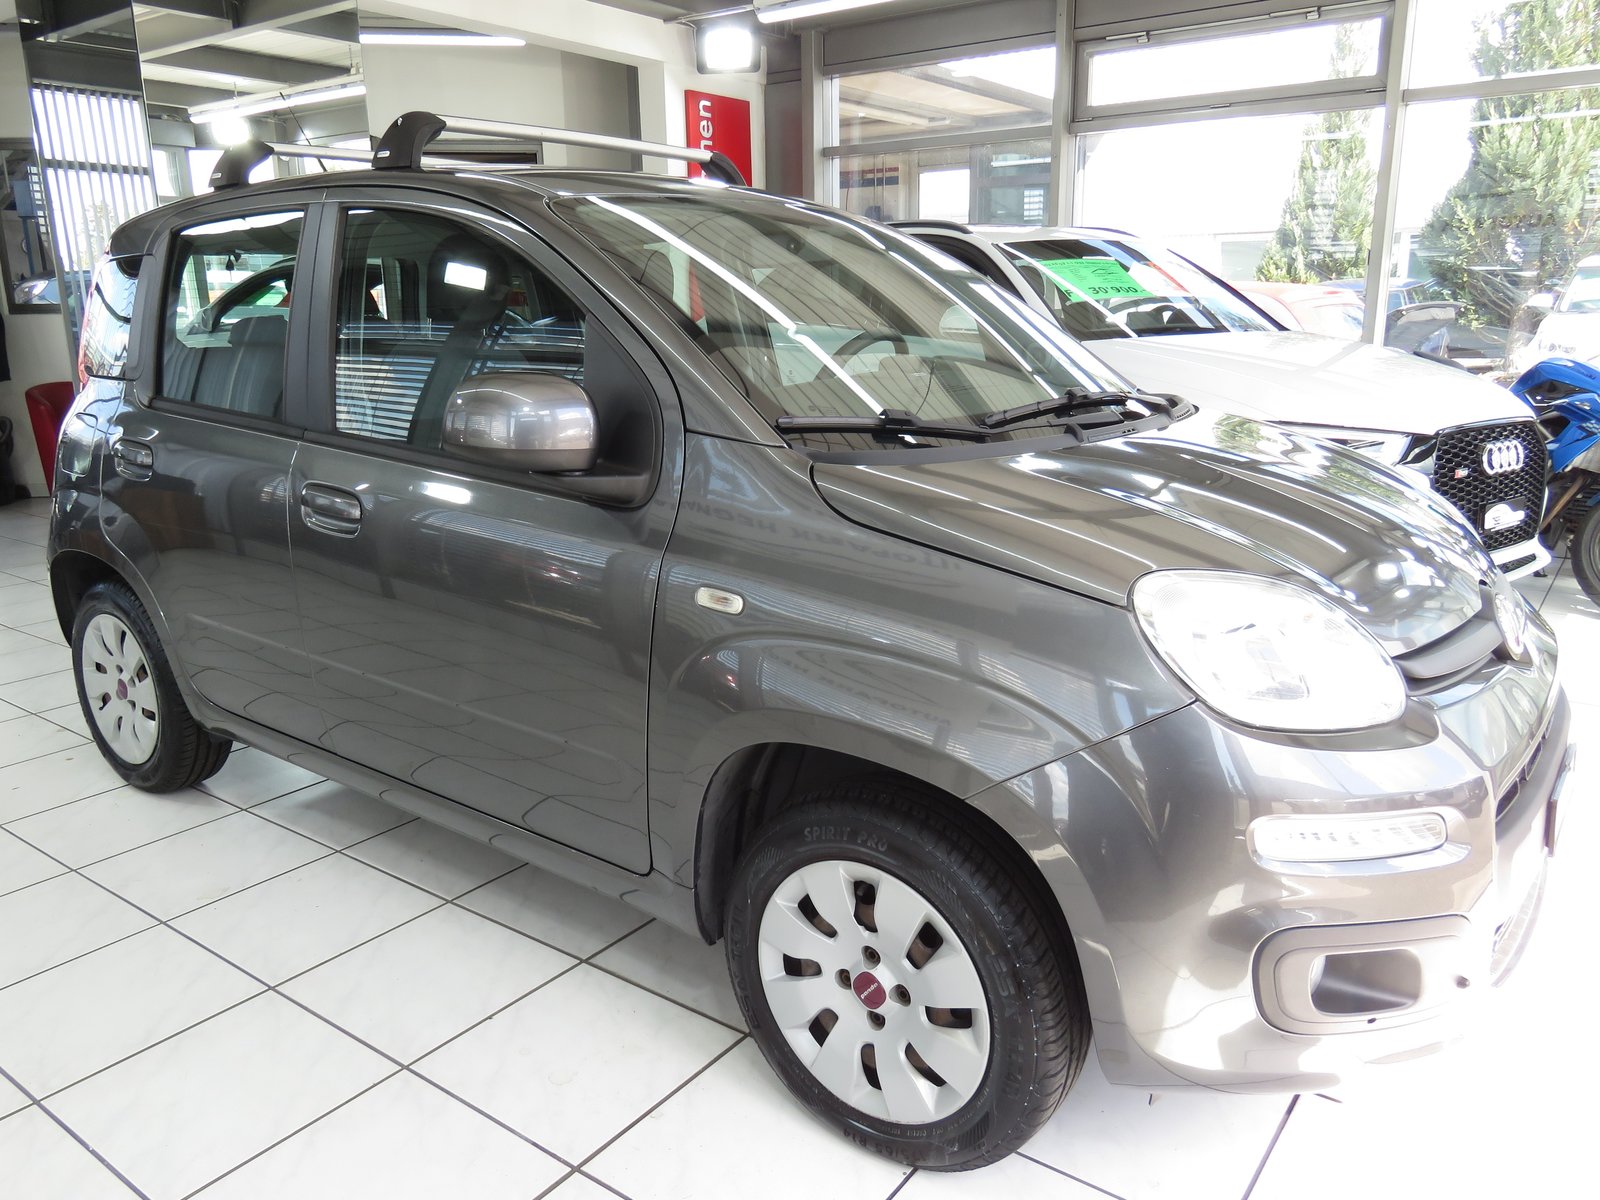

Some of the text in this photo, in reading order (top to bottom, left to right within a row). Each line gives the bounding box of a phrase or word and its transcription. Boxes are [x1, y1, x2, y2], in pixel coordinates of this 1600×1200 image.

[803, 825, 889, 852] SPIRIT PRO
[860, 982, 879, 1000] panda
